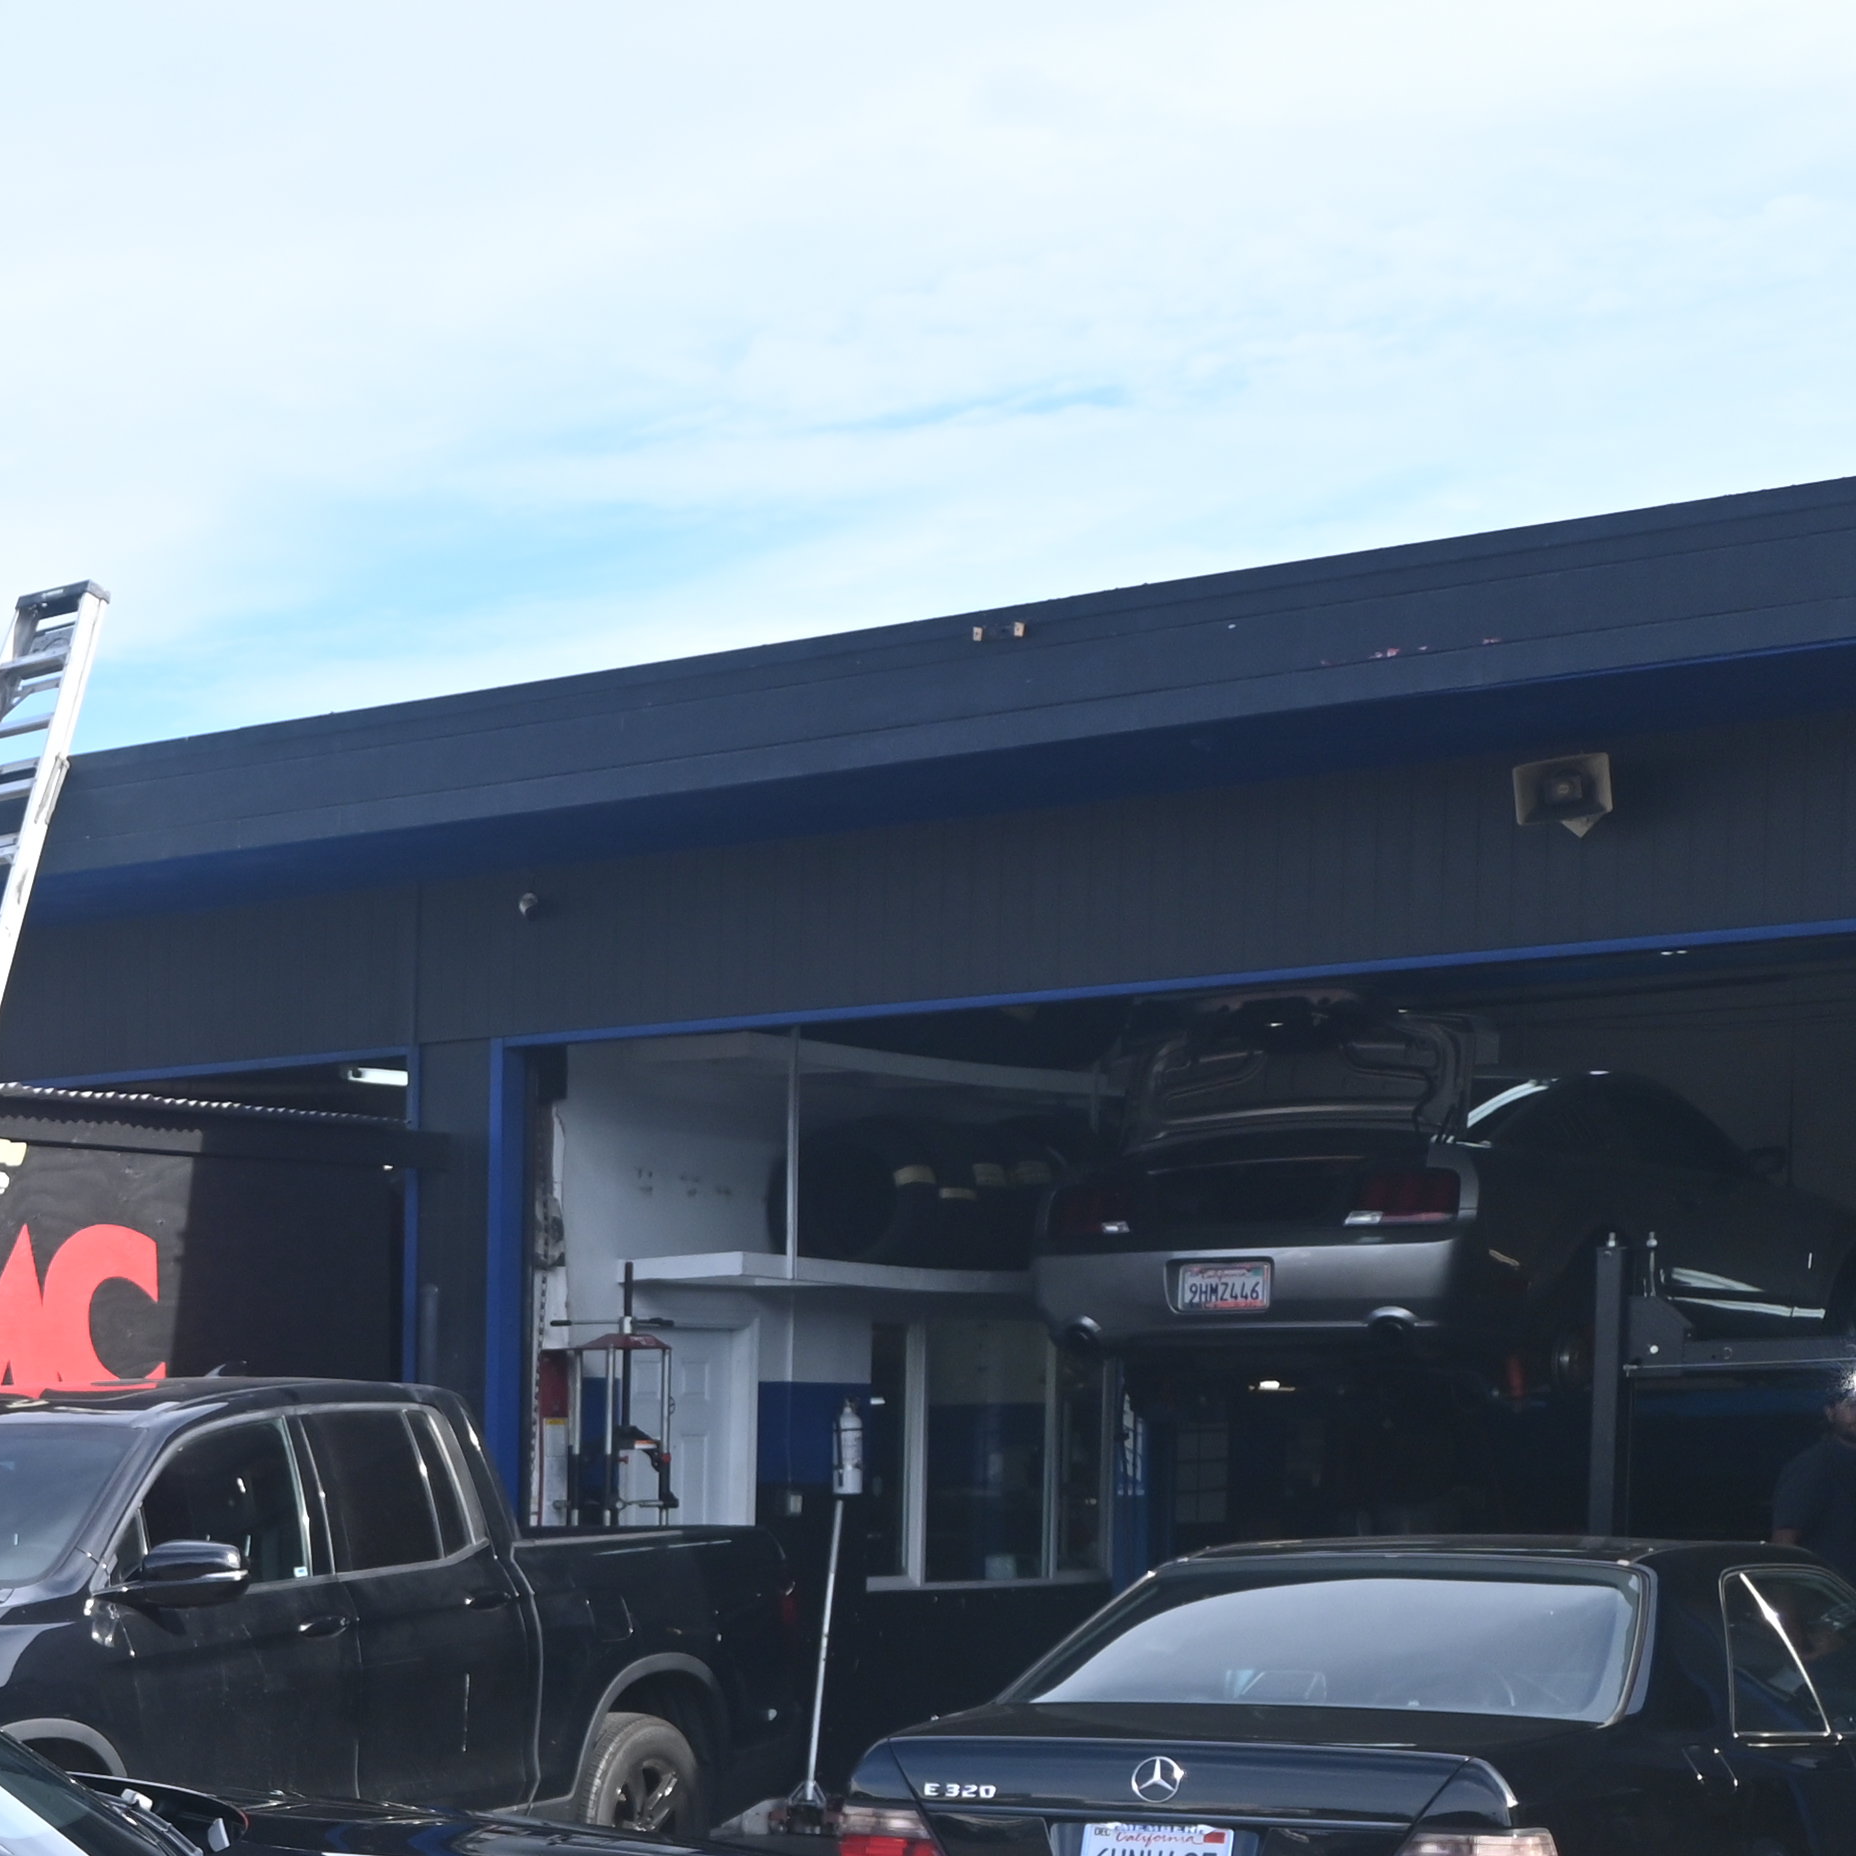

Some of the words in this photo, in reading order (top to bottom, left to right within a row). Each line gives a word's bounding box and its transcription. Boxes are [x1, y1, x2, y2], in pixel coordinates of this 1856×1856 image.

[1189, 1281, 1260, 1304] 9HMZ446
[924, 1782, 940, 1796] E
[945, 1783, 997, 1798] 320
[1116, 1832, 1204, 1847] California
